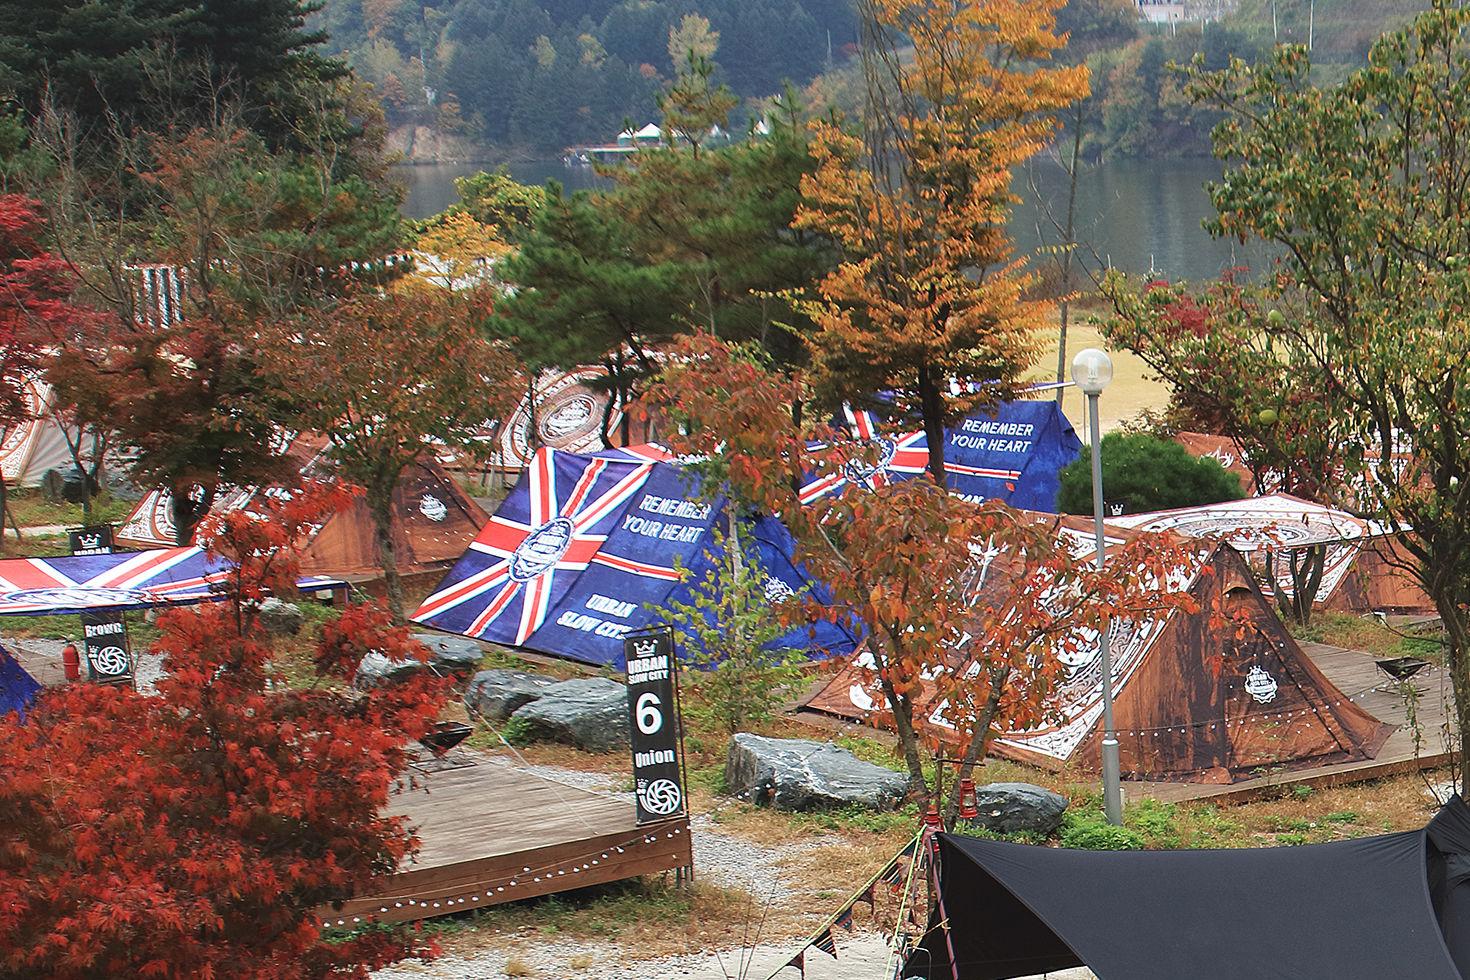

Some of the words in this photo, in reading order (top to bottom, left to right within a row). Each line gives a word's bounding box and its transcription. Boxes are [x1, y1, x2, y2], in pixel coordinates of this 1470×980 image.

[962, 419, 1034, 436] REMEMBER
[950, 433, 987, 450] YOUR
[987, 439, 1032, 453] HEART
[639, 494, 712, 520] REMEMBER
[622, 514, 664, 538] YOUR
[659, 523, 705, 544] HEART
[585, 594, 639, 618] URBAN
[557, 610, 603, 632] SLOW
[627, 654, 669, 675] URBAN
[628, 673, 649, 685] SLOW
[649, 669, 669, 681] CITY
[635, 692, 663, 735] 6
[635, 749, 675, 768] Union
